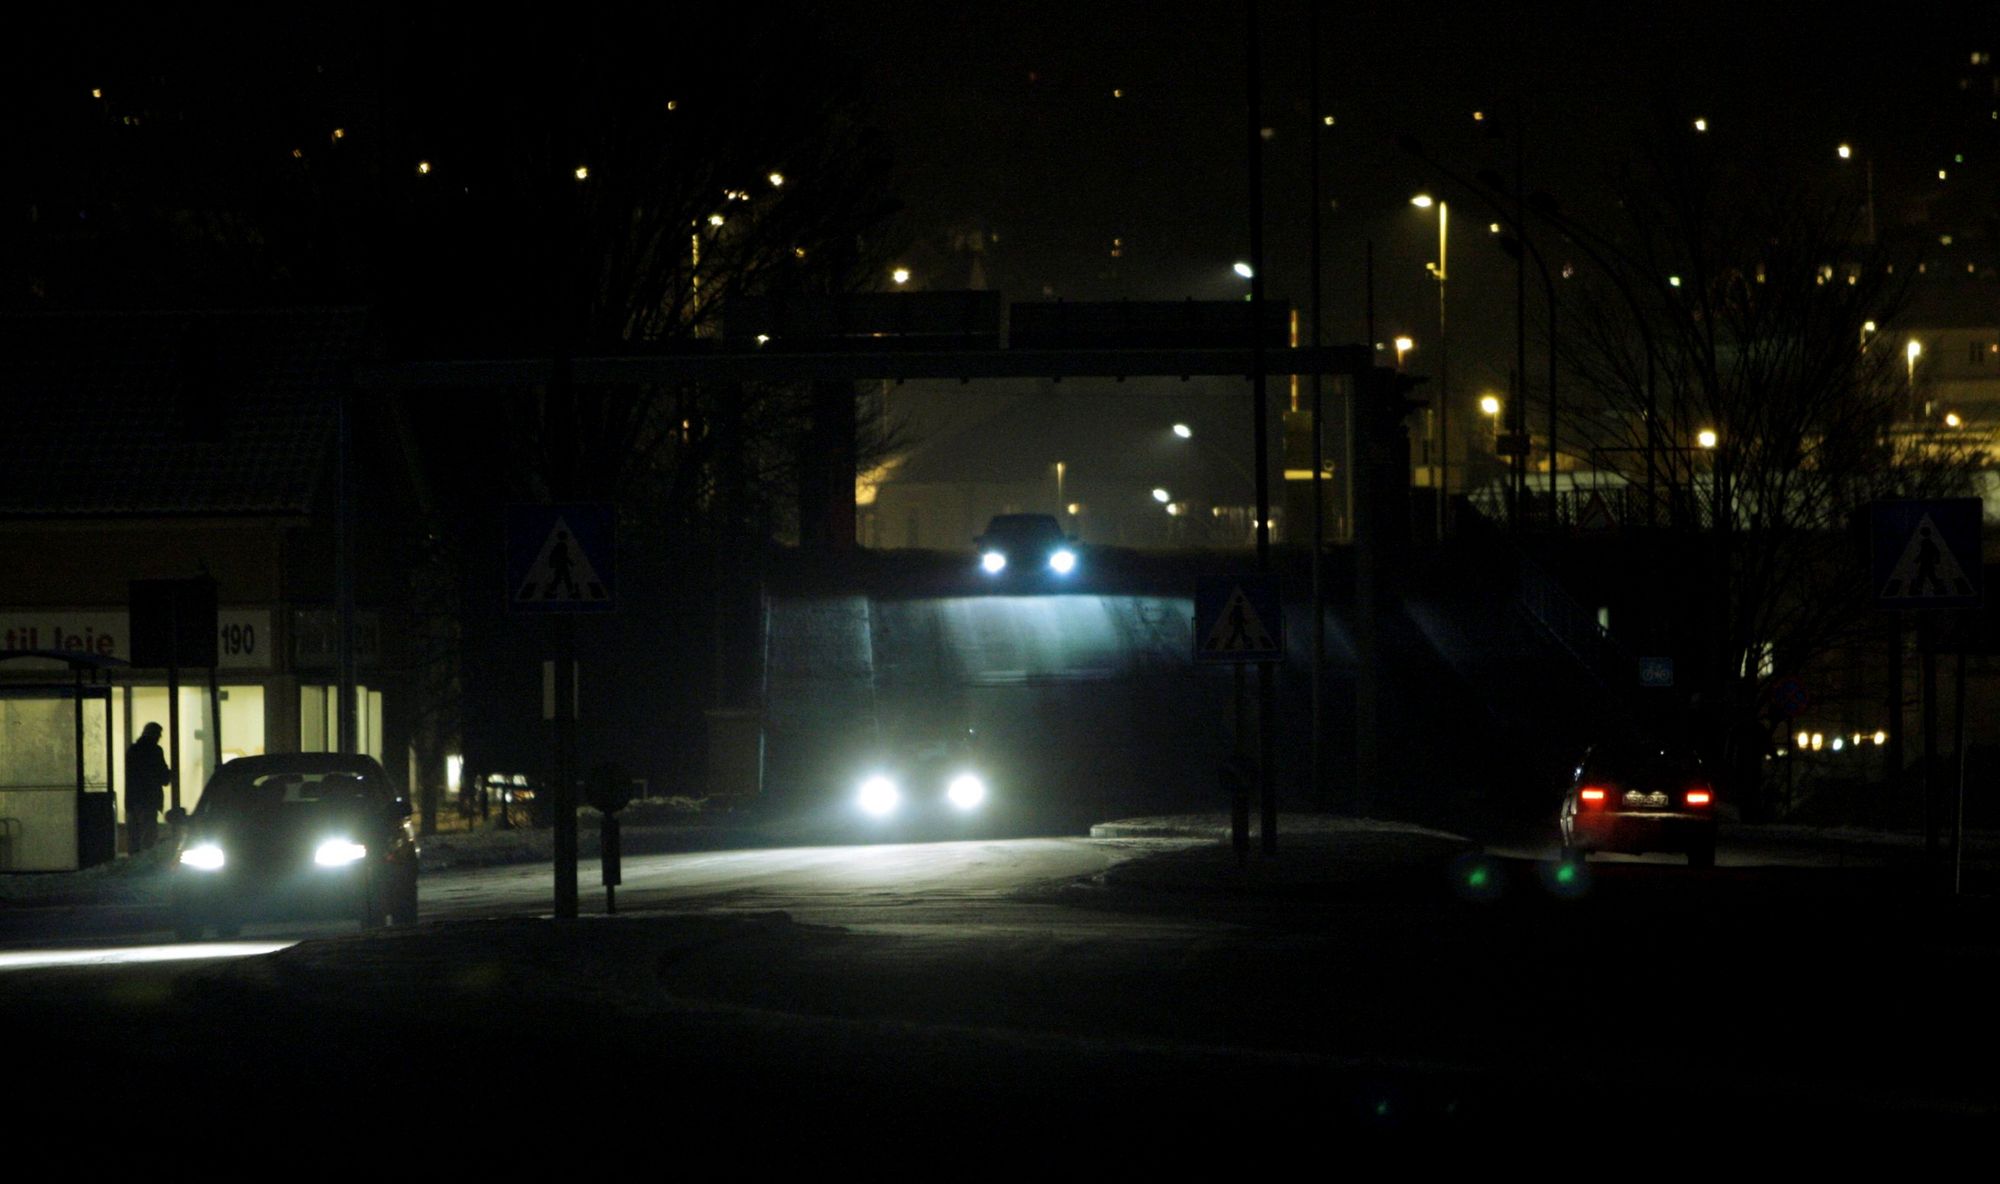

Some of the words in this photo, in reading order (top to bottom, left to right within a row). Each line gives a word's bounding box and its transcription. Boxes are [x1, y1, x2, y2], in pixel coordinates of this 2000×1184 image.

[6, 627, 37, 652] til
[55, 626, 114, 657] leie
[221, 623, 254, 655] 190
